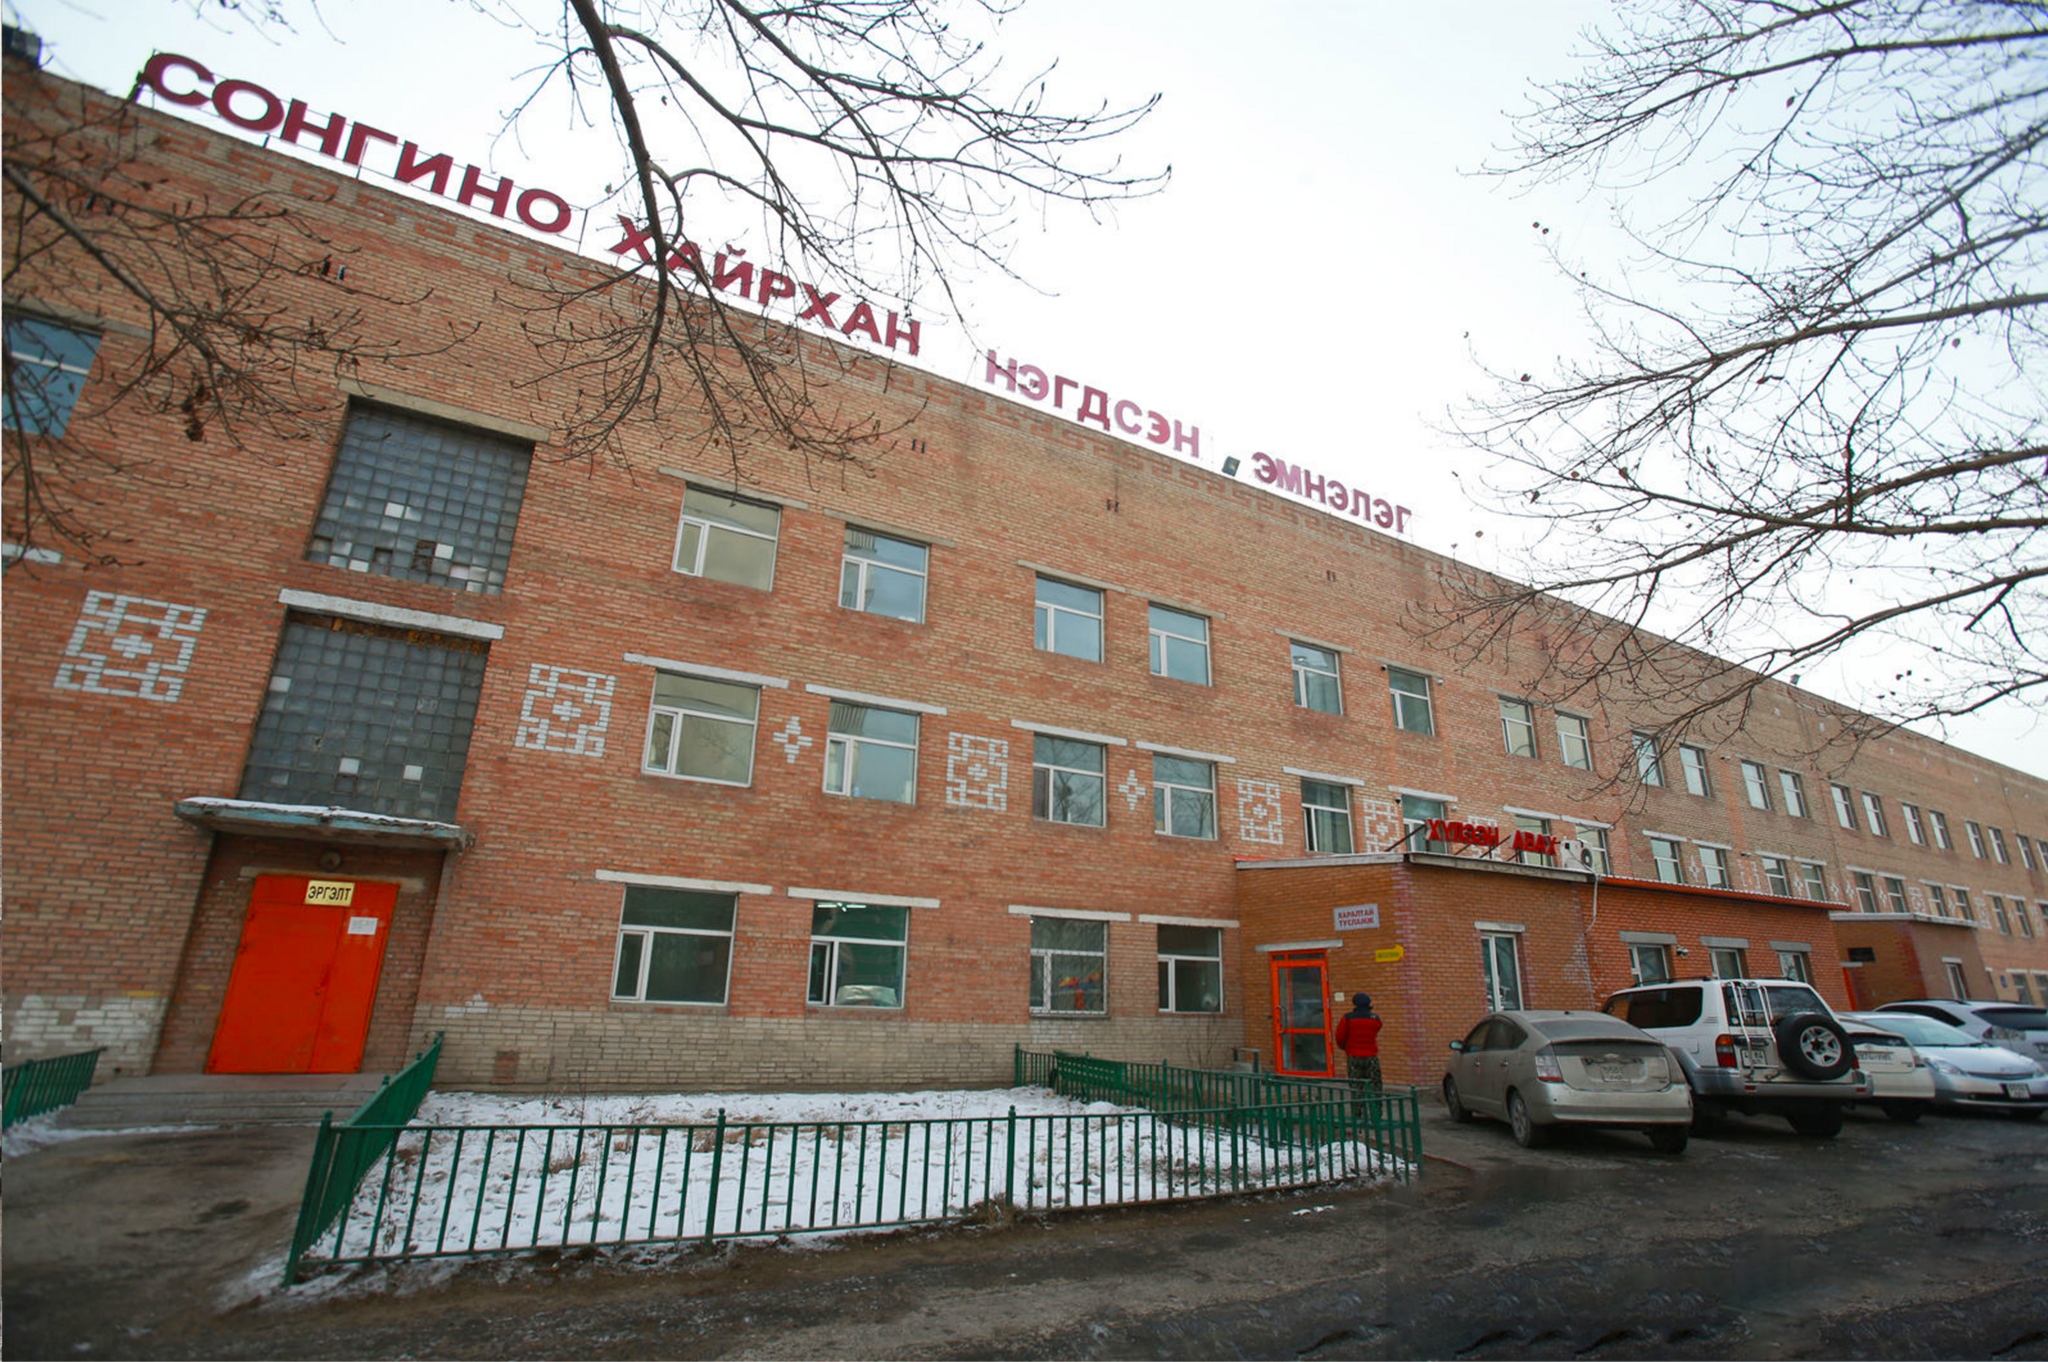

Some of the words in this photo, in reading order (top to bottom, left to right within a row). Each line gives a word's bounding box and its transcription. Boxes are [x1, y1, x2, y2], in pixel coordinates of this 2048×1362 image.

[143, 52, 572, 234] СОНГИНО
[606, 214, 921, 357] ХАЙРХАН
[985, 349, 1200, 458] НЭГДСЭН
[1251, 451, 1412, 533] ЭМНЭЛЭГ
[1511, 829, 1558, 857] АВАХ
[307, 885, 352, 901] ЭРГЭЛТ
